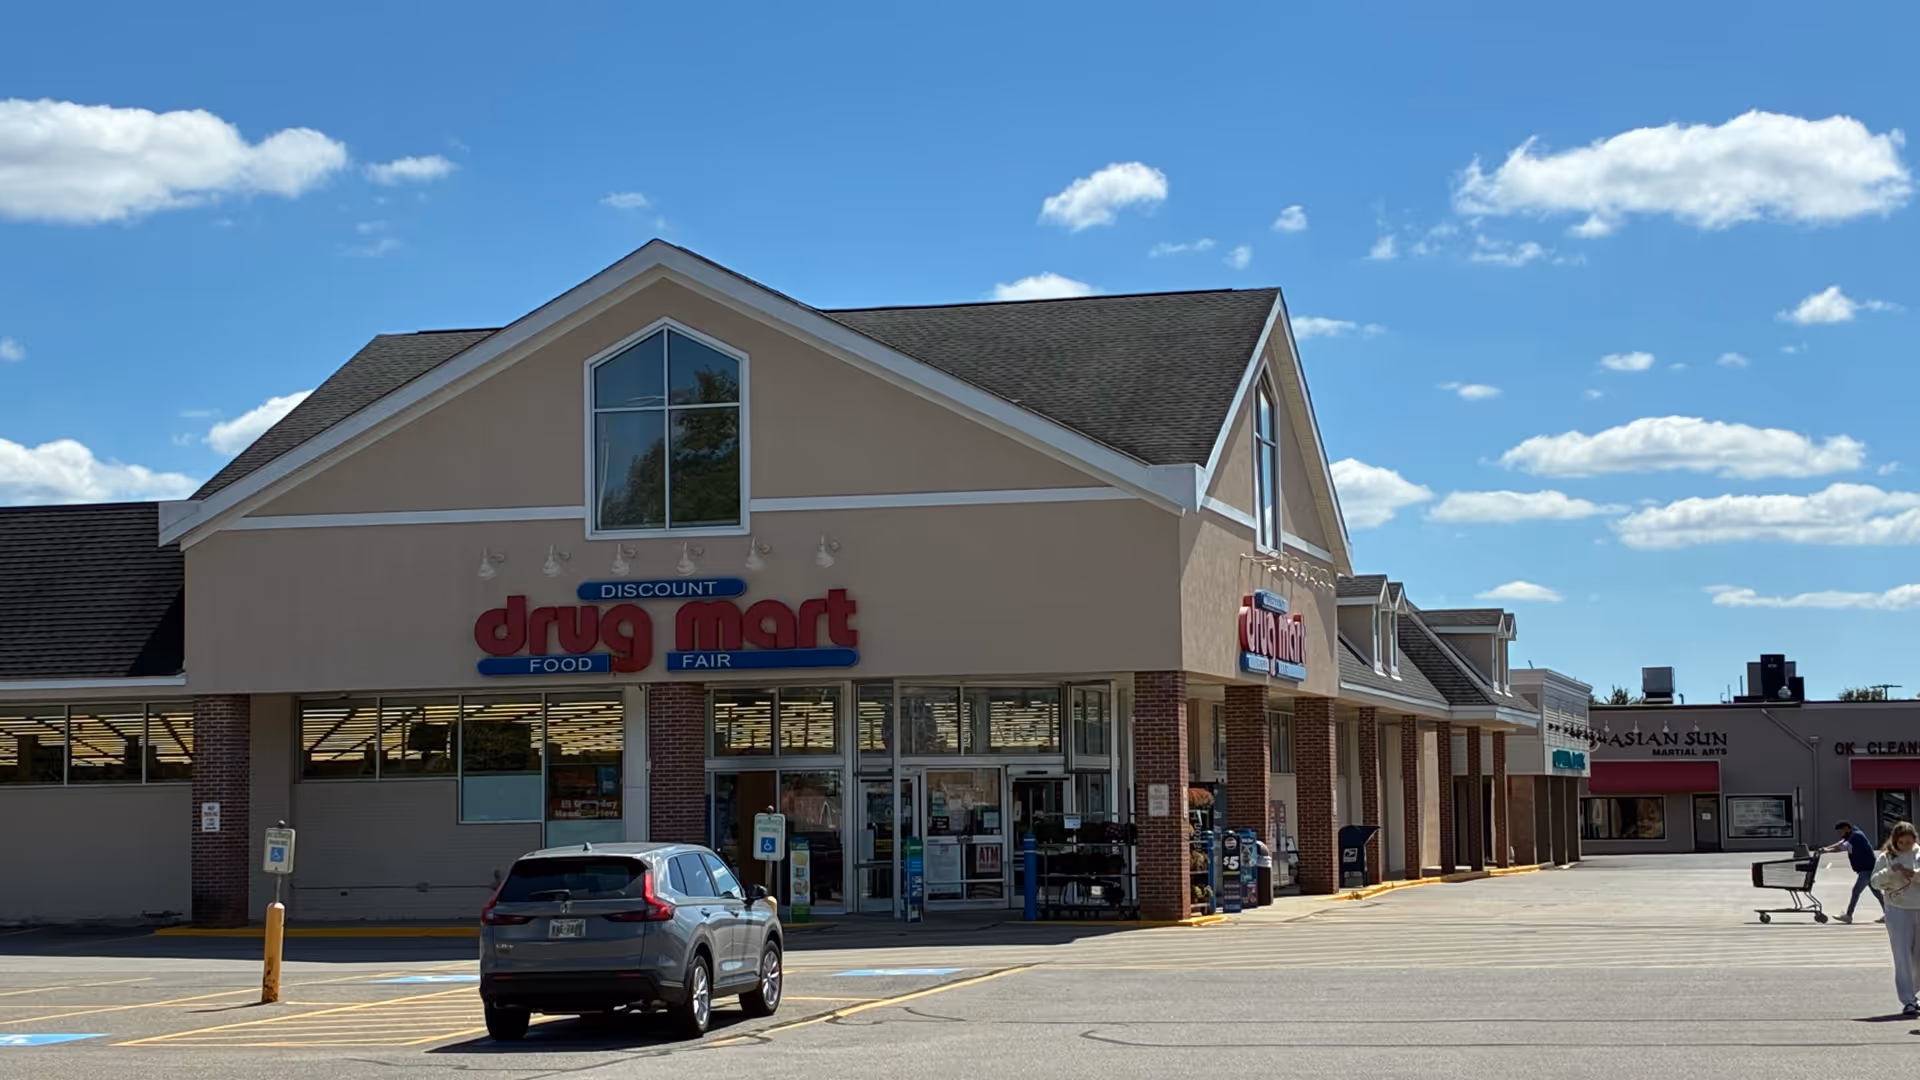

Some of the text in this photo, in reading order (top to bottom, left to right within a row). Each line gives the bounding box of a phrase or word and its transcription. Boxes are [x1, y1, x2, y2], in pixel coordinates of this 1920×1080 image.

[600, 581, 718, 598] DISCOUNT
[474, 589, 858, 673] drug mart
[1240, 594, 1277, 676] drug
[529, 653, 731, 673] FOOD FAIR
[1608, 731, 1728, 748] ASIAN SUN
[1652, 748, 1728, 756] MARTIAL ARTS
[1834, 741, 1920, 756] OK CLEAN
[978, 846, 999, 864] ATM
[1222, 855, 1240, 870] $5
